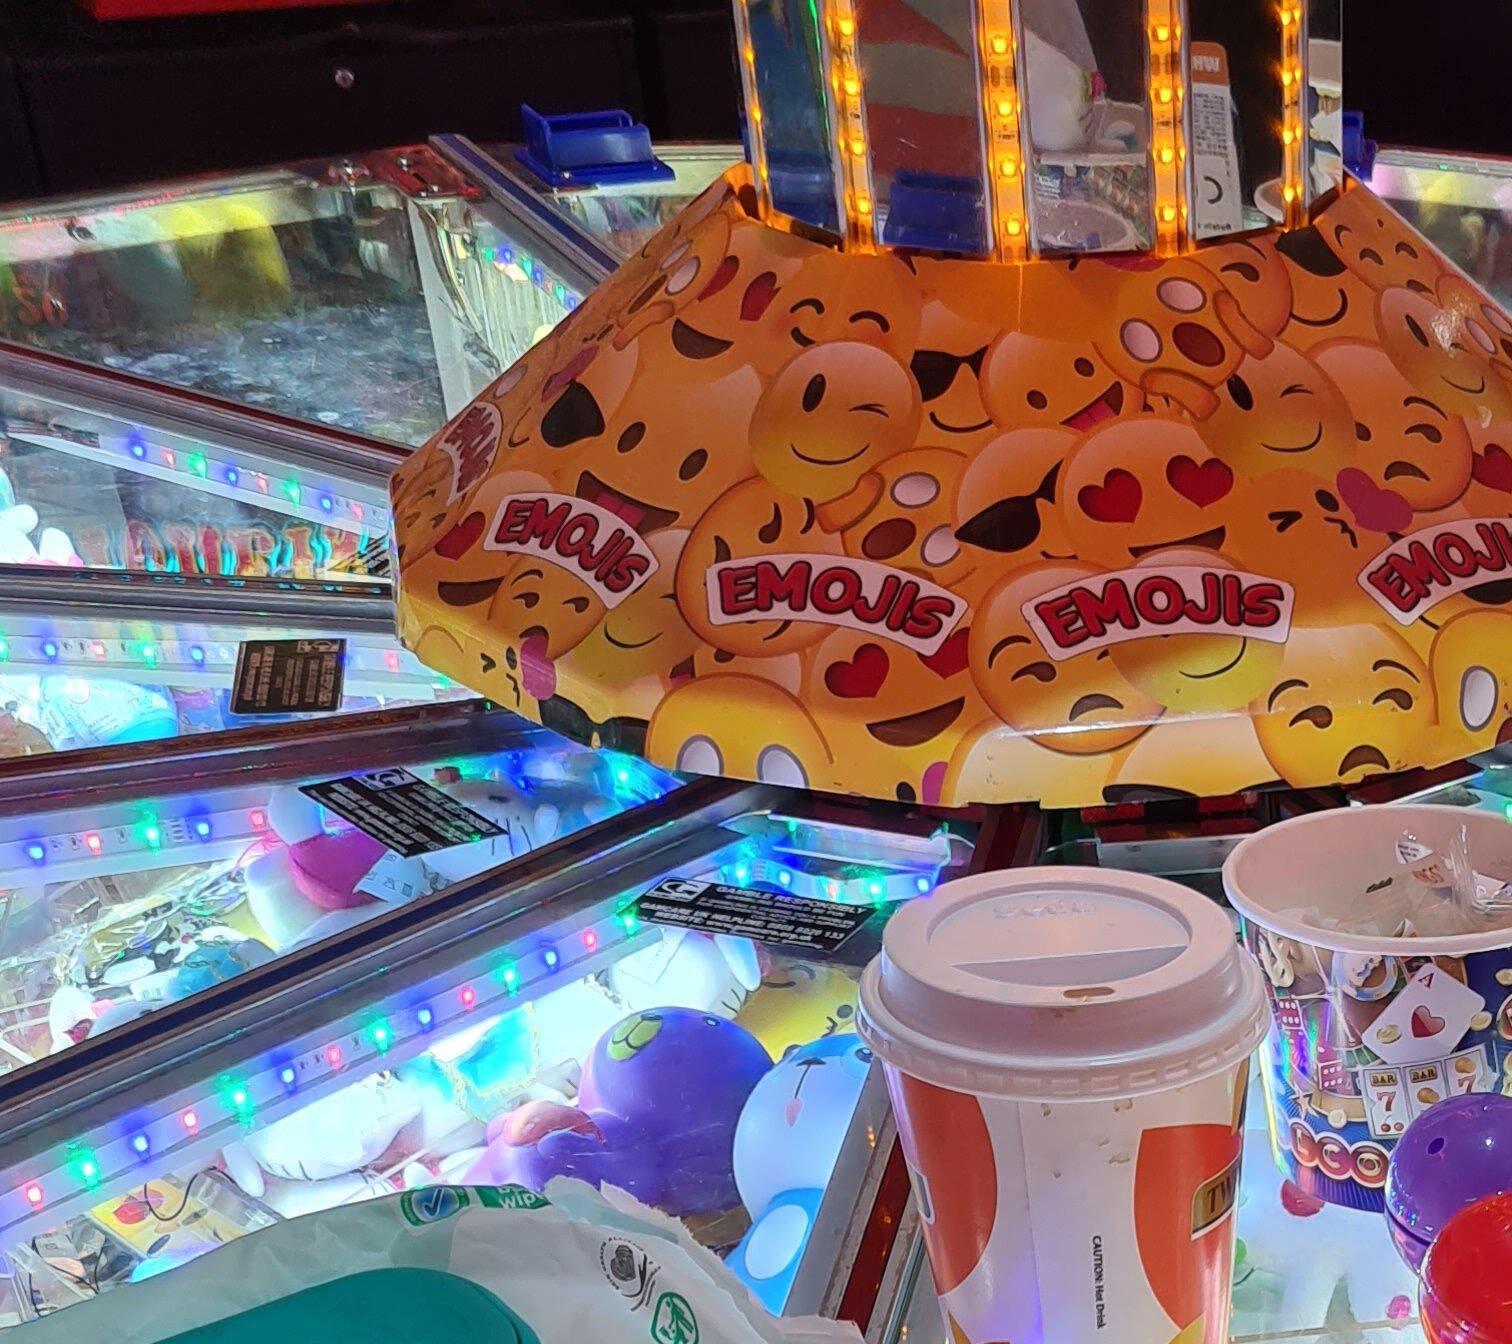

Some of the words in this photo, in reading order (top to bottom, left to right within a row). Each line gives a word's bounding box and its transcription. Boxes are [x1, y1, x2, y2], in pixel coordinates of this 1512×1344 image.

[494, 498, 651, 594] EMOJIS
[717, 561, 957, 639] EMOJIS
[1035, 572, 1286, 649] EMOJIS
[715, 886, 773, 901] GAMBLE
[1372, 1074, 1395, 1085] BAR
[1411, 1069, 1436, 1082] BAR
[1376, 1091, 1397, 1112] 7
[1092, 1234, 1105, 1285] CAUTION:
[1095, 1285, 1104, 1302] Hot
[1096, 1303, 1106, 1329] Drink
